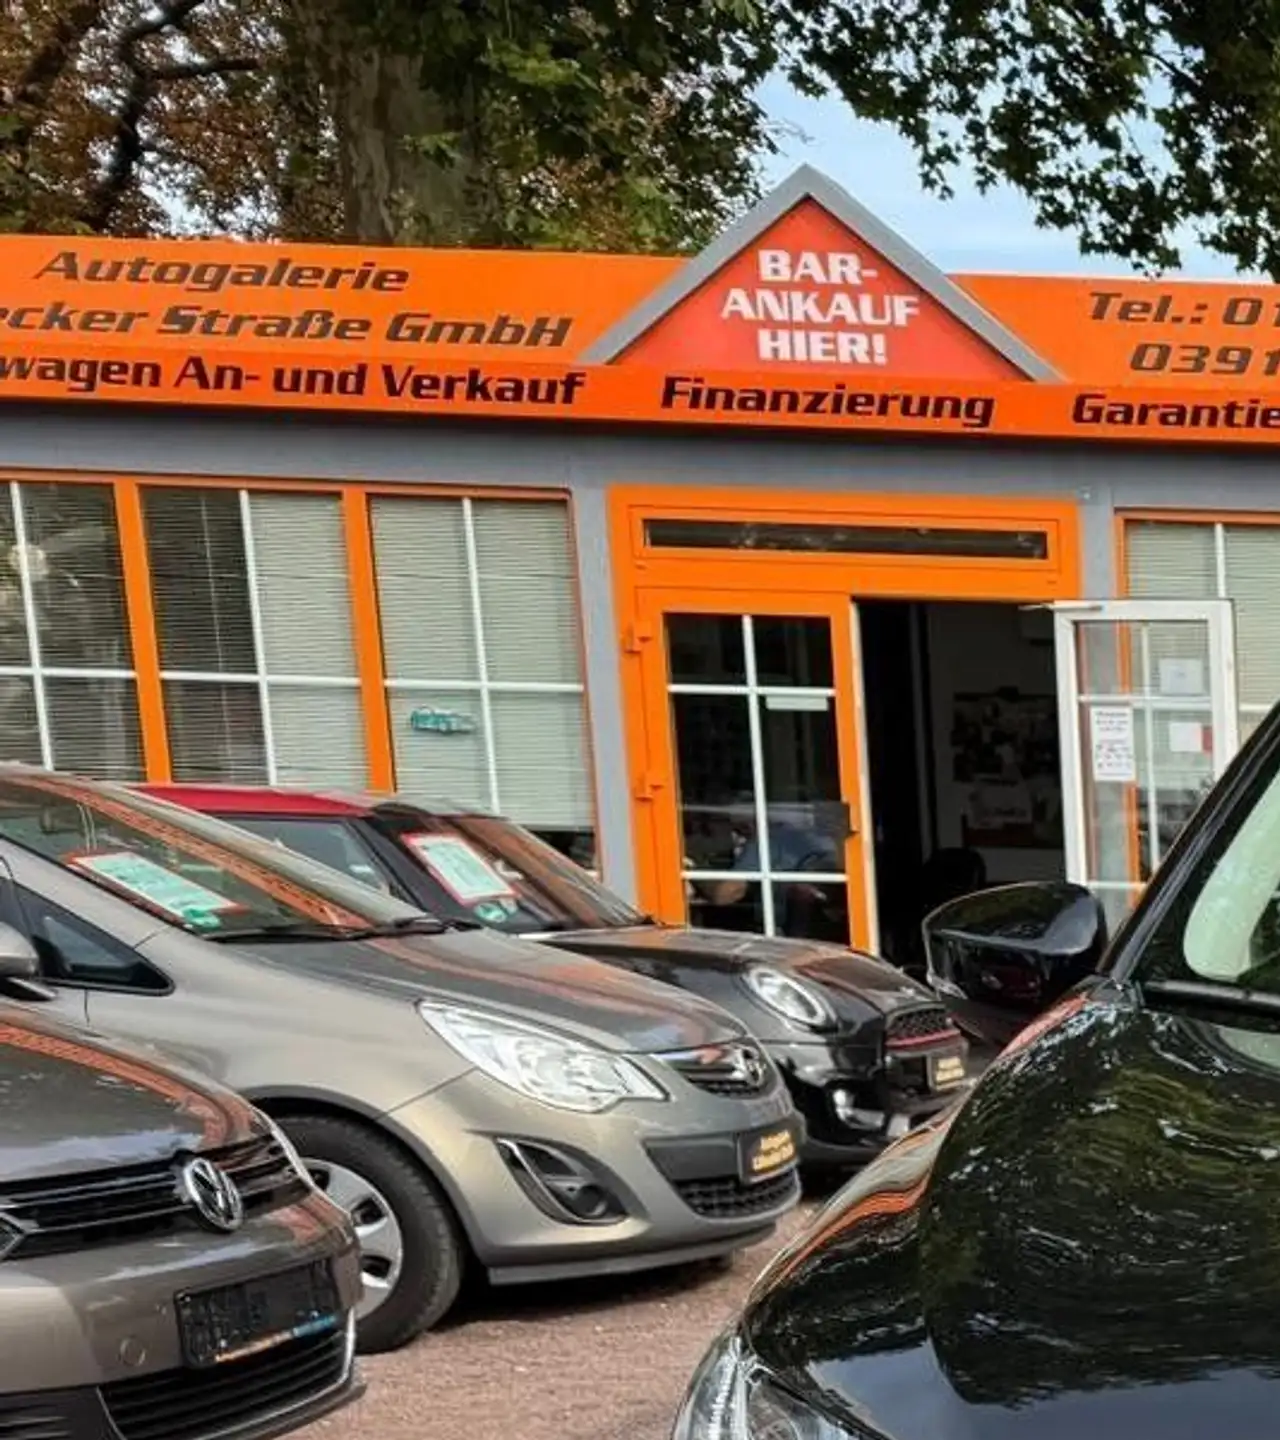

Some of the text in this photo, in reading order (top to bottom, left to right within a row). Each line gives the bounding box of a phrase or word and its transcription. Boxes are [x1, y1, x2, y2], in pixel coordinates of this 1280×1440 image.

[33, 251, 409, 293] Autogalerie
[758, 249, 878, 285] BAR-
[0, 300, 573, 347] cker Straße GmbH
[720, 287, 920, 326] ANKAUF
[1090, 292, 1208, 324] Tel.:
[758, 329, 888, 365] HIER!
[173, 355, 260, 390] An-
[273, 363, 368, 396] und
[382, 364, 586, 405] Verkauf
[660, 376, 996, 428] Finanzierung
